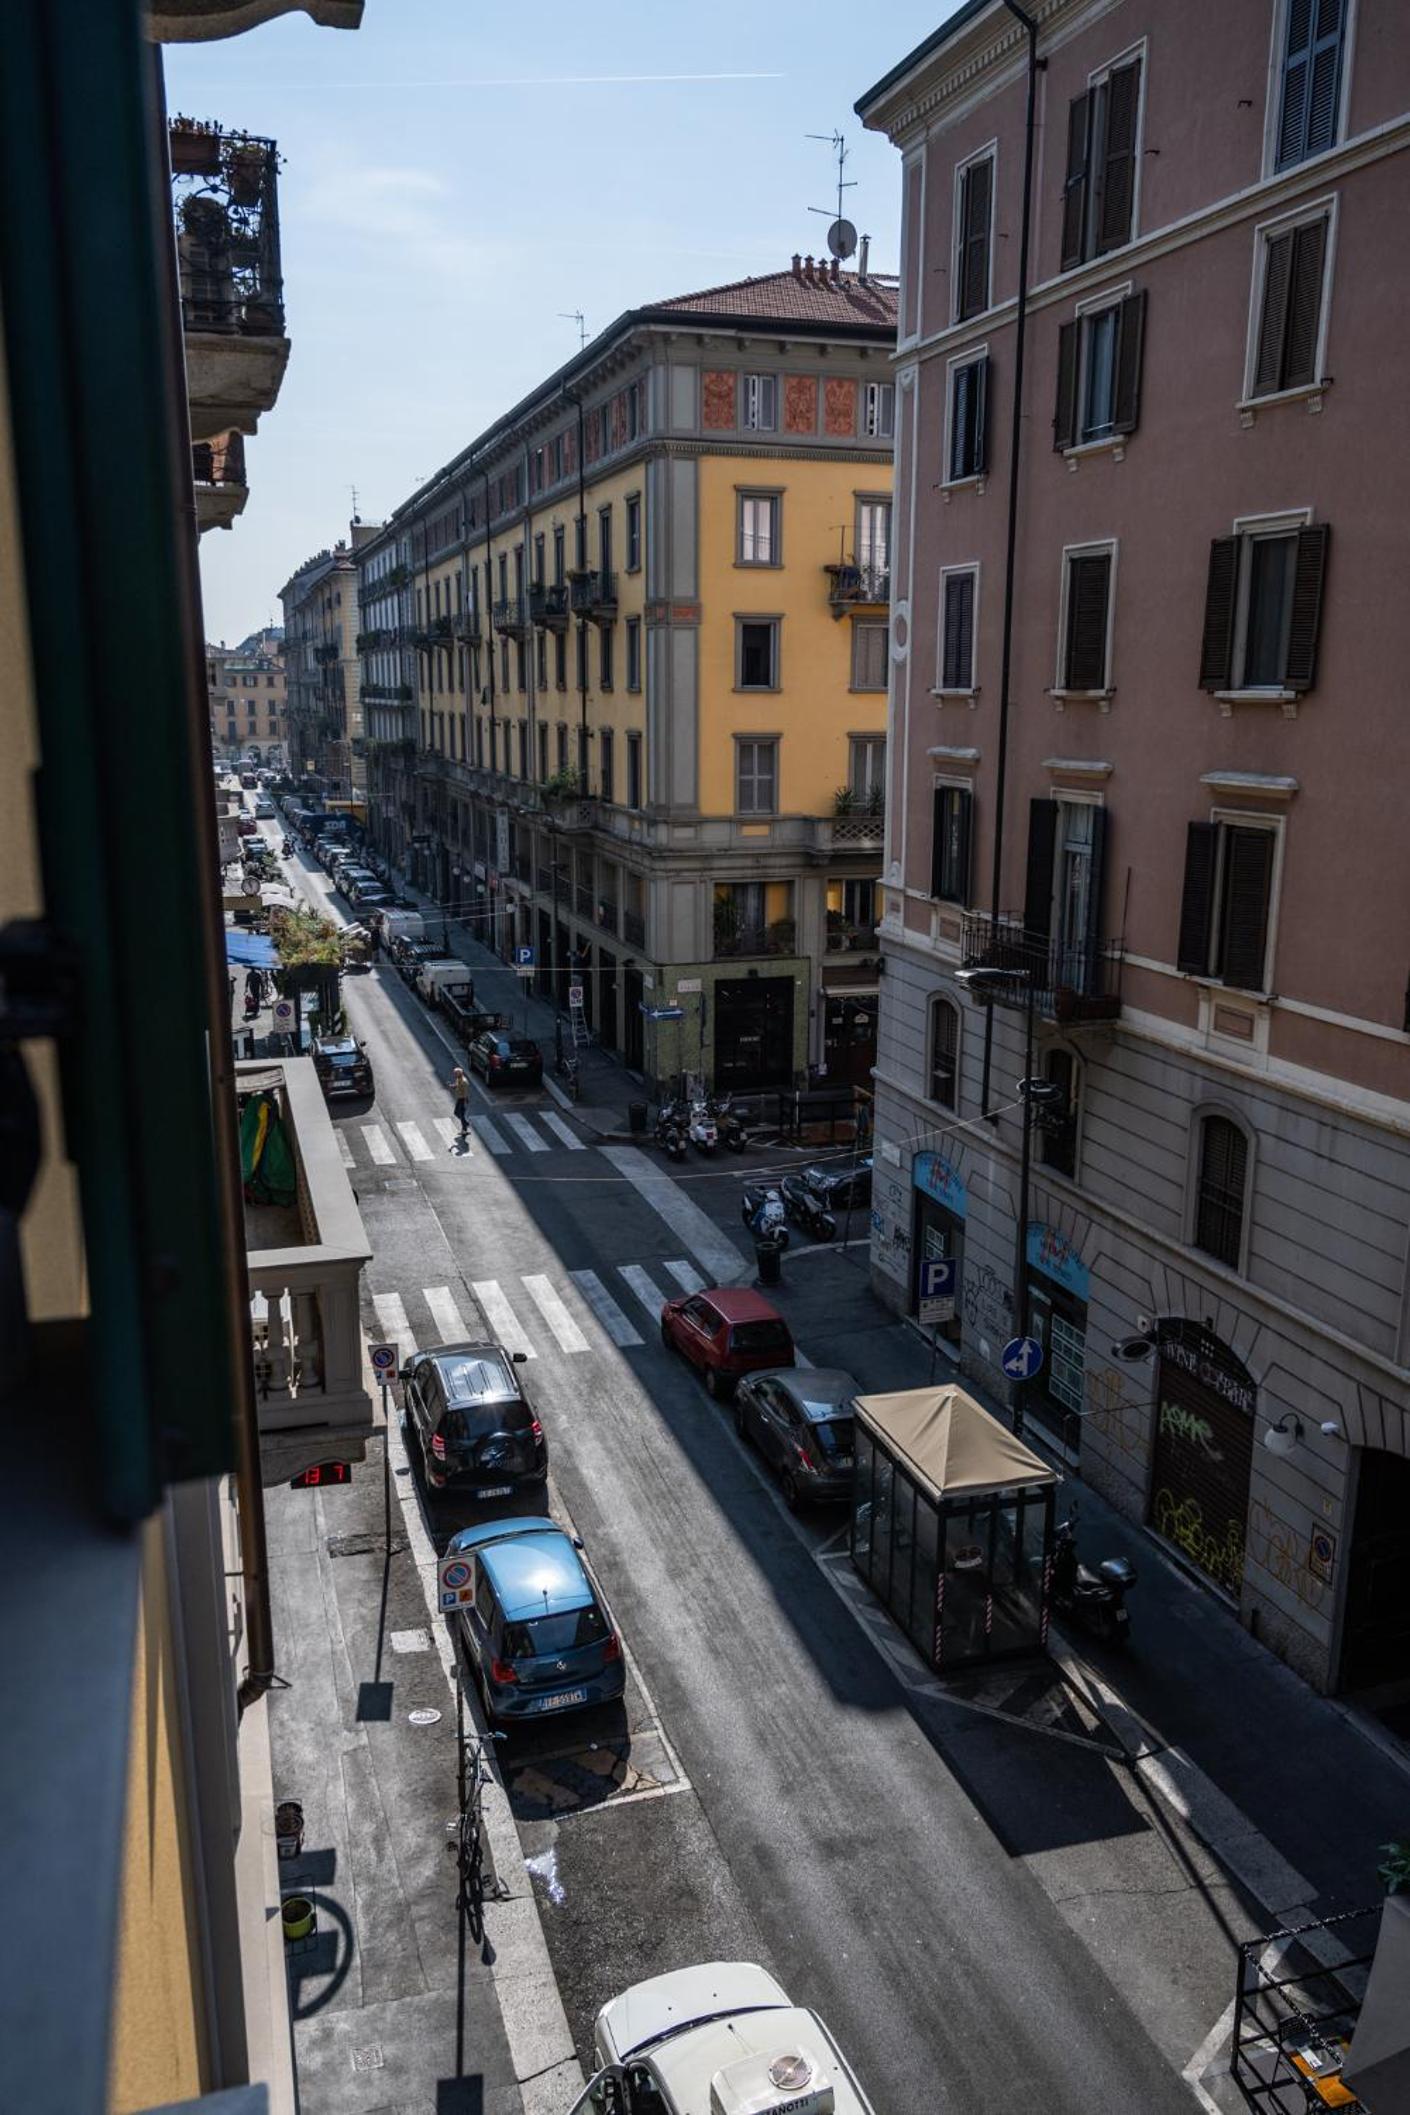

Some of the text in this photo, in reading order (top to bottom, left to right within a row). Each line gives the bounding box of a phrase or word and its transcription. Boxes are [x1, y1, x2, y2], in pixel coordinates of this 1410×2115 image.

[520, 948, 532, 963] P
[927, 1263, 949, 1294] P
[445, 1594, 454, 1604] P
